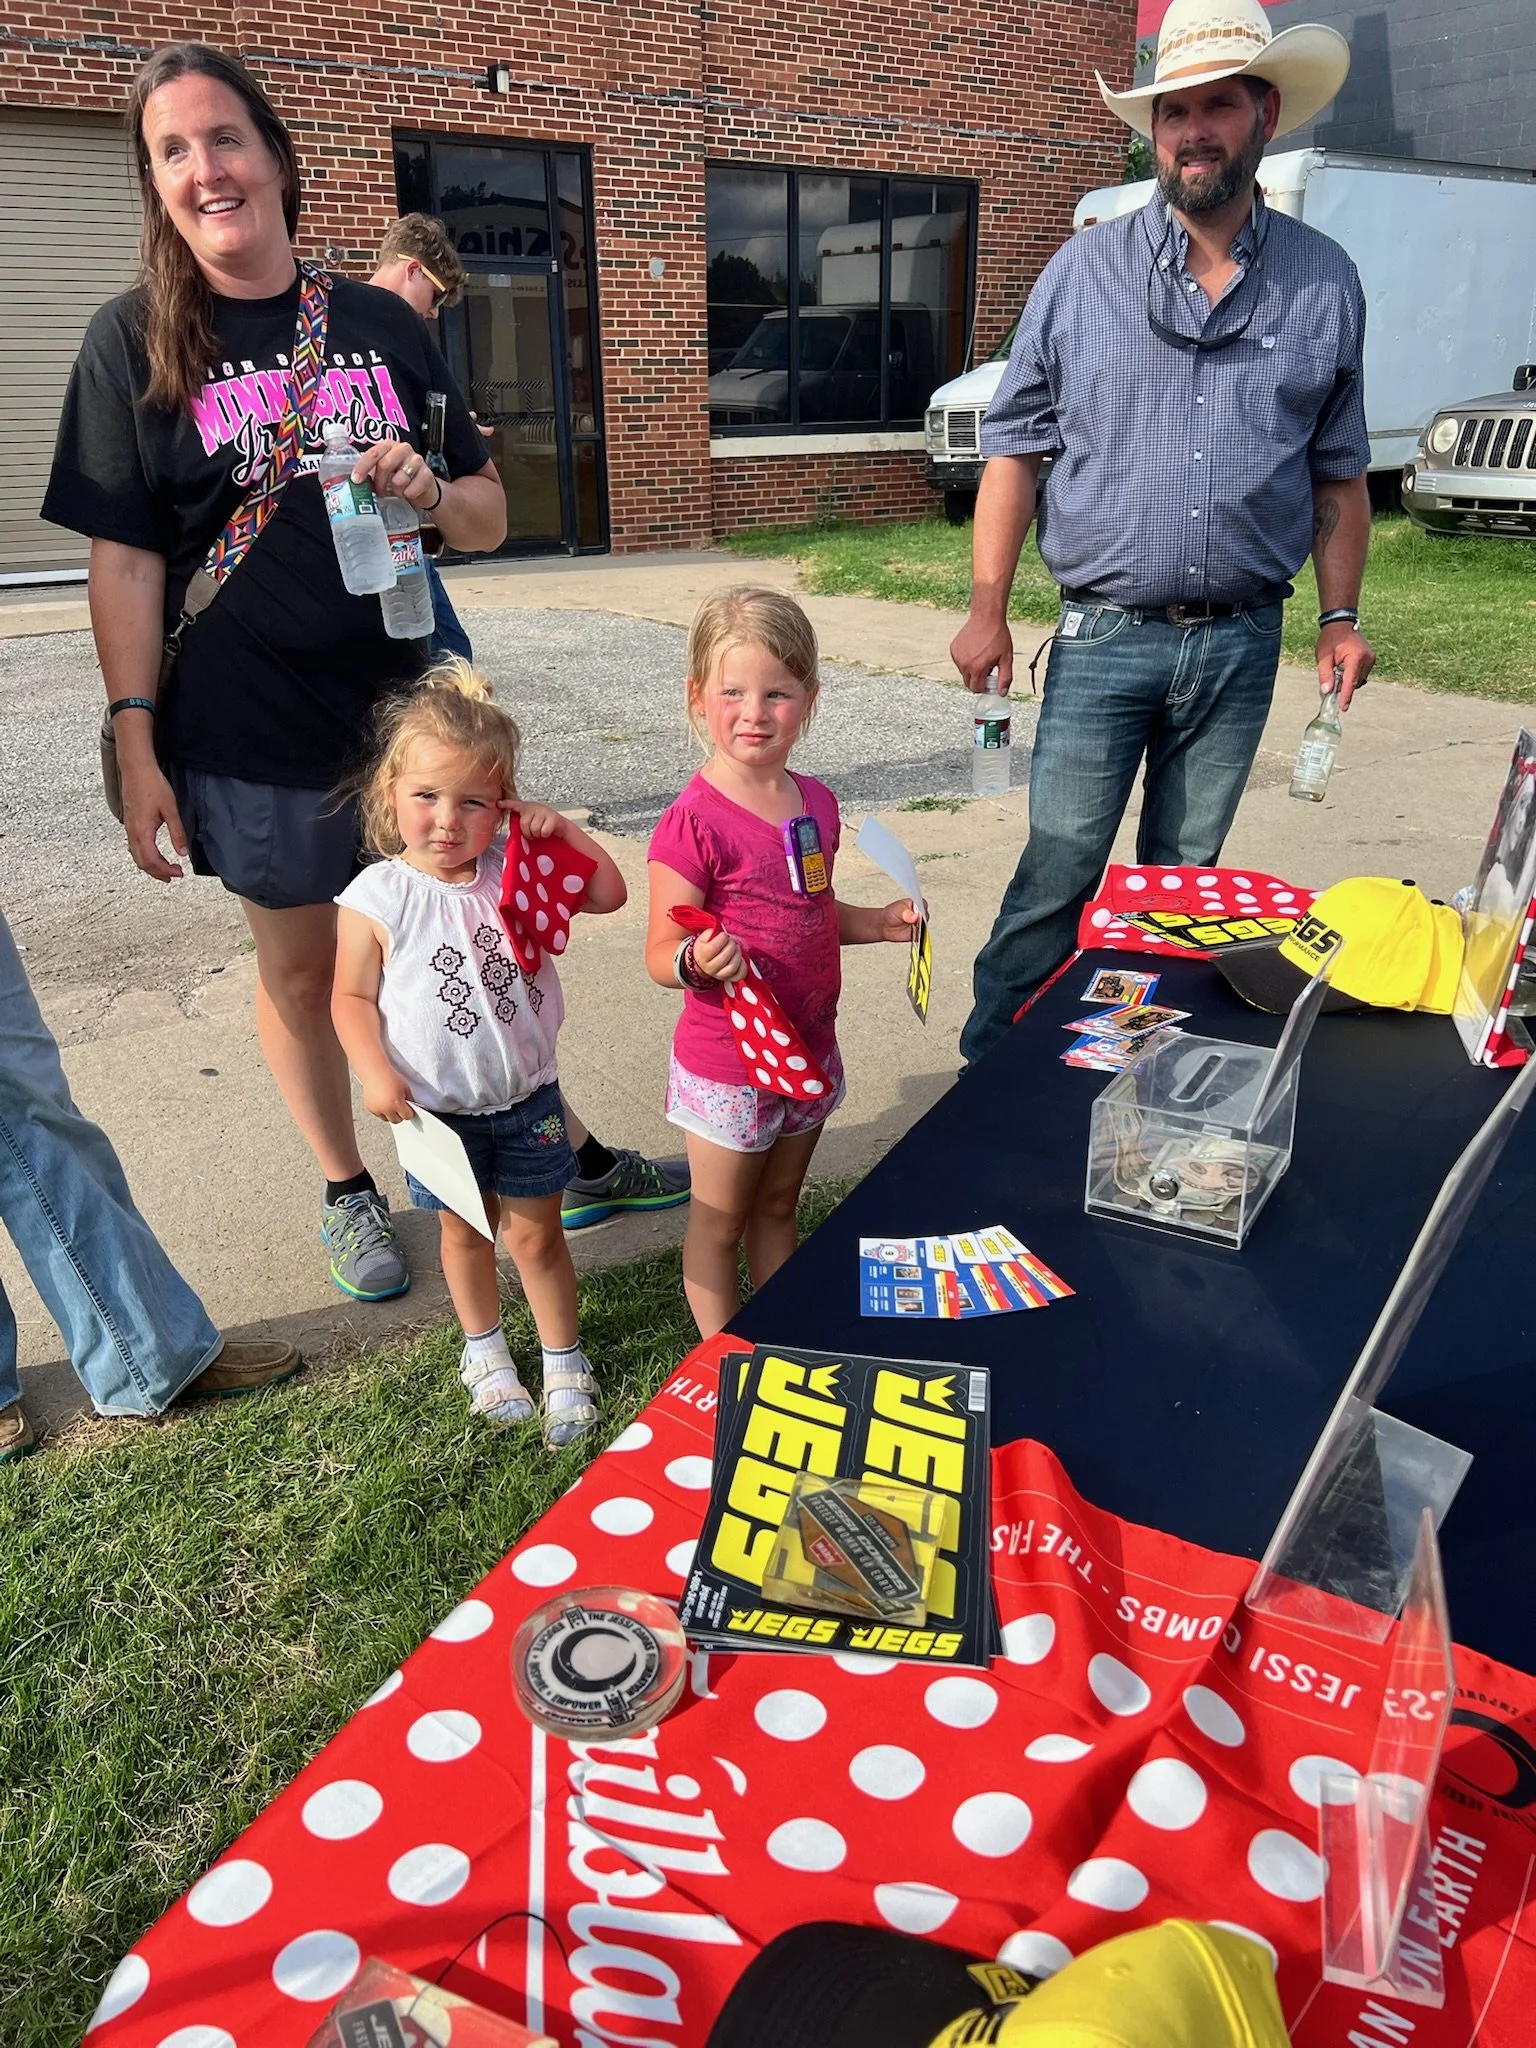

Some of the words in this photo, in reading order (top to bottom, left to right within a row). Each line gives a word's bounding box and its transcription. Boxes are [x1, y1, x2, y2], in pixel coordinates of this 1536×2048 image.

[207, 360, 256, 379] IGH
[276, 350, 383, 367] SOOL
[190, 365, 411, 458] MINNSOTA
[304, 399, 401, 443] odeo
[392, 544, 418, 563] zarka
[664, 1376, 718, 1413] RTH
[820, 1495, 859, 1533] JESSI
[857, 1535, 907, 1591] COMBS
[1039, 1523, 1093, 1584] THE
[607, 1614, 635, 1629] JESSI
[727, 1608, 841, 1644] JEGS
[1115, 1595, 1242, 1653] COMBS
[849, 1625, 965, 1657] JEGS
[1249, 1645, 1362, 1709] JESSI
[551, 1694, 602, 1710] EMPOWER
